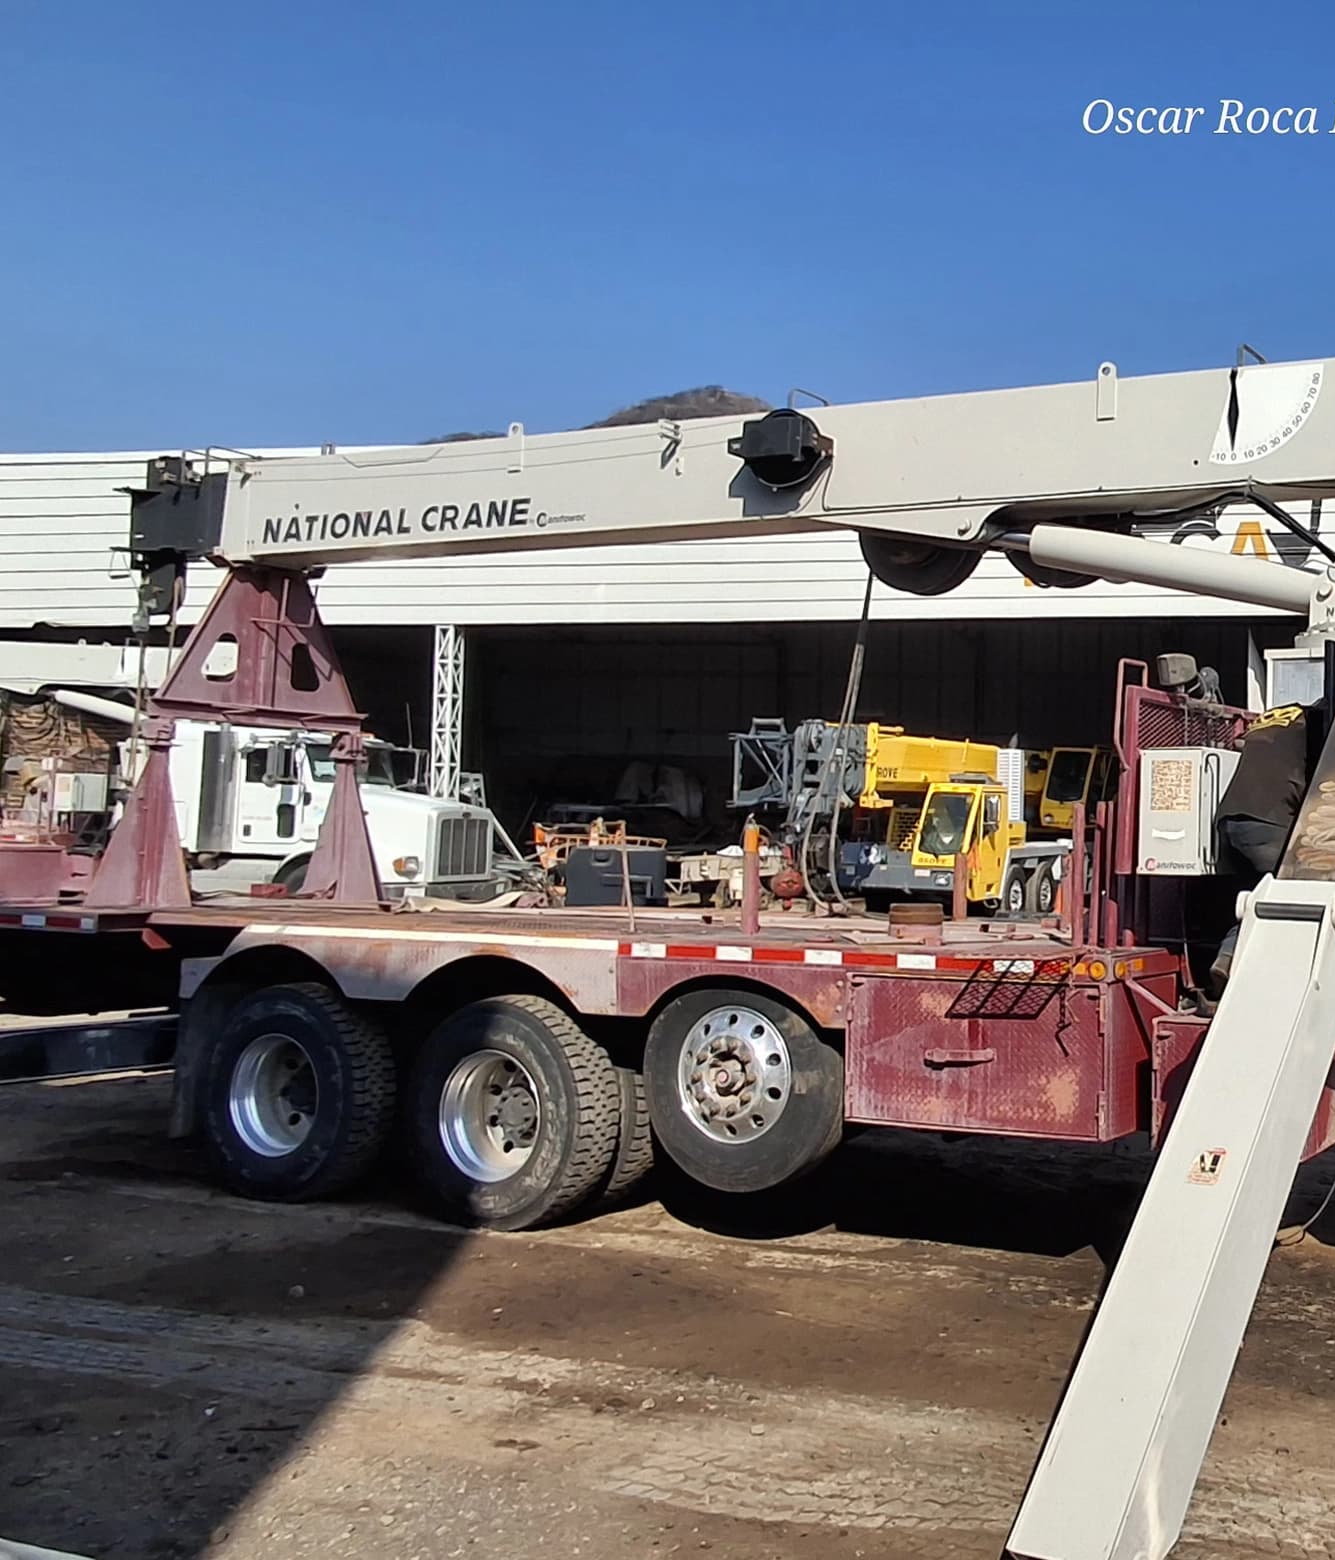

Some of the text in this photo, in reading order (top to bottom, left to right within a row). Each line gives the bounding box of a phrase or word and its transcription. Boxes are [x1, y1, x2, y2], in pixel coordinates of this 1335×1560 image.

[1311, 372, 1321, 386] 80
[1306, 387, 1318, 400] 70
[1300, 401, 1312, 415] 60
[1291, 414, 1303, 428] 50
[1281, 426, 1293, 439] 40
[1268, 436, 1281, 449] 30
[1243, 450, 1255, 460] 10
[1256, 443, 1269, 456] 20
[262, 508, 412, 545] NATIONAL
[420, 497, 532, 533] CRANE
[876, 767, 899, 779] ROVE
